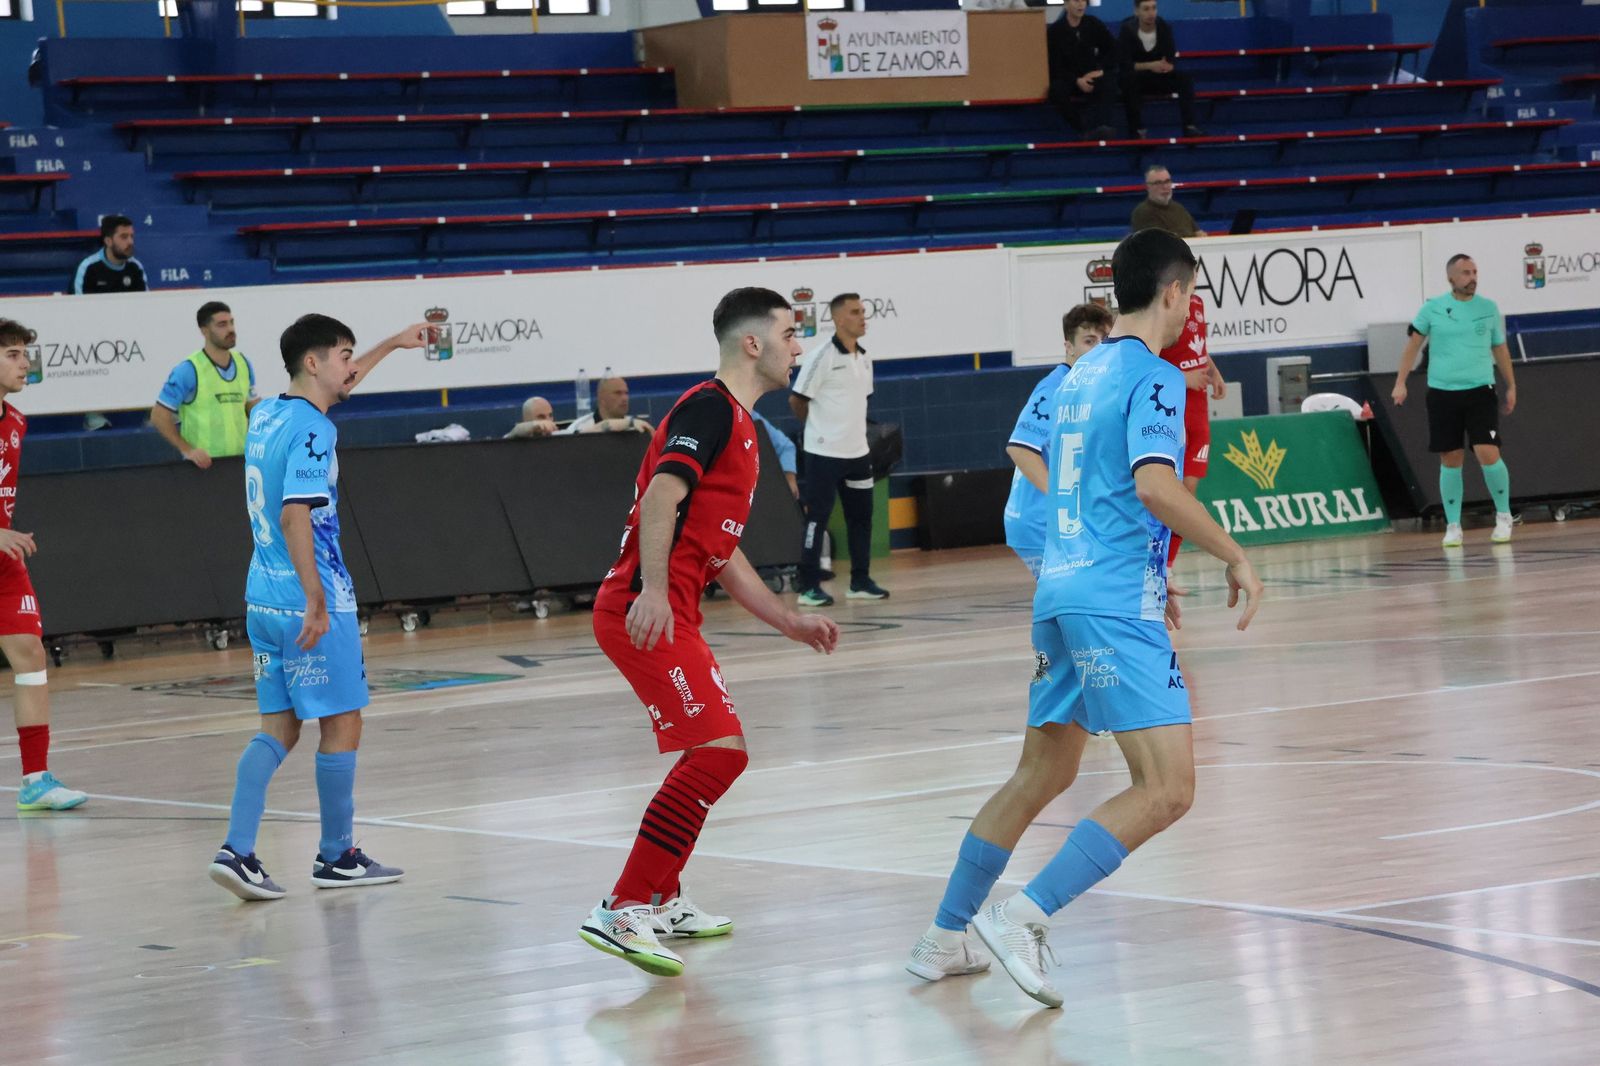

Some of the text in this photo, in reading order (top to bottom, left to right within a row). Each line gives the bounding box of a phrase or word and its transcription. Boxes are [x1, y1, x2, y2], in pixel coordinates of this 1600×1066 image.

[847, 29, 961, 48] AYUNTAMIENTO
[847, 50, 962, 72] DE ZAMORA
[144, 214, 152, 226] 4
[1548, 251, 1600, 275] ZAMOR
[1195, 247, 1363, 308] AMORA
[820, 299, 897, 322] ZORA
[455, 319, 543, 344] ZAMORA
[1205, 317, 1288, 338] TAMIENTO
[46, 340, 145, 367] ZAMORA
[47, 368, 109, 379] AYUNTAMIENTO
[1057, 432, 1084, 539] 5
[300, 675, 329, 687] .com
